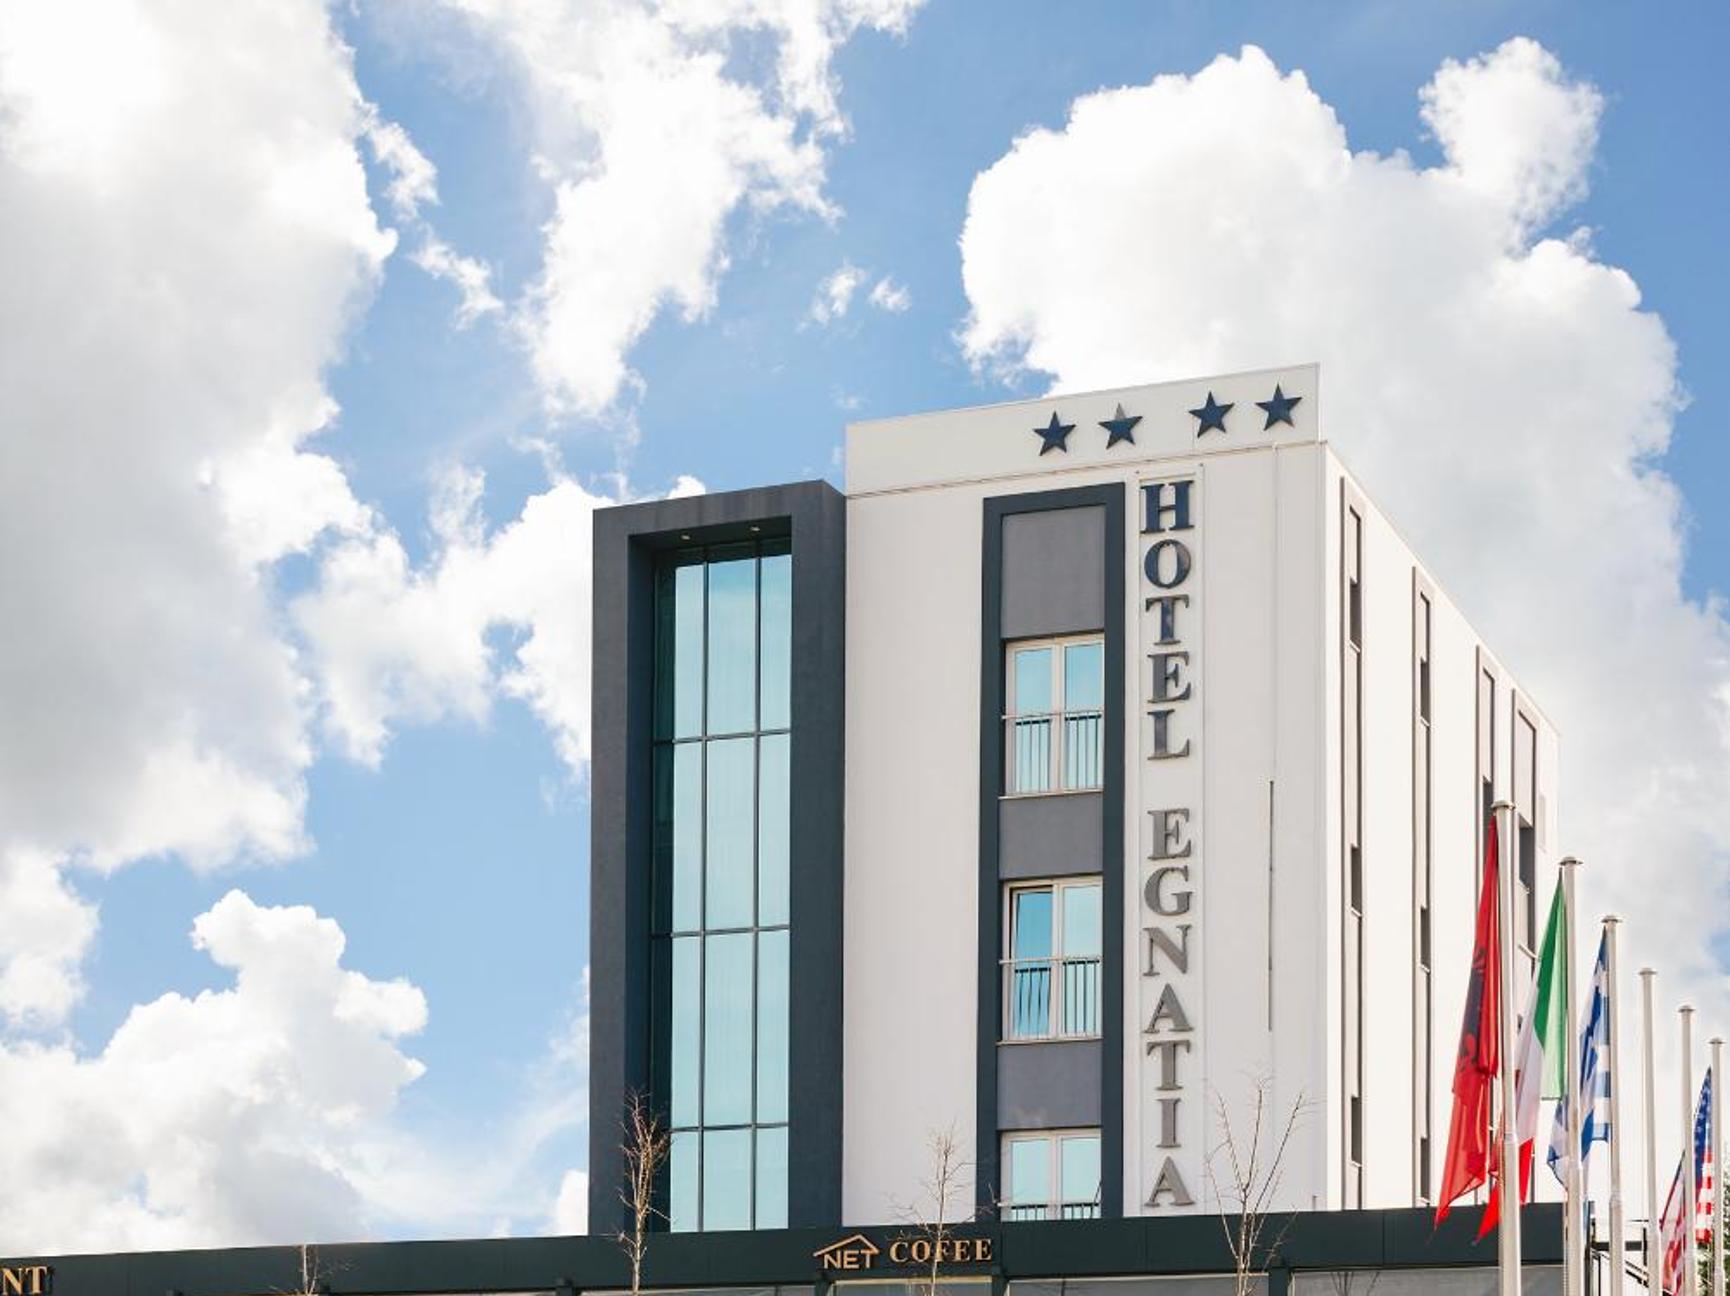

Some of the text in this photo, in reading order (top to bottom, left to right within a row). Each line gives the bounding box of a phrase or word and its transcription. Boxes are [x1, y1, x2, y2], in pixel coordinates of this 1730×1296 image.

[1140, 479, 1195, 1208] HOTEL EGNATIA
[823, 1239, 992, 1269] NET COFEE
[2, 1266, 48, 1296] NT
